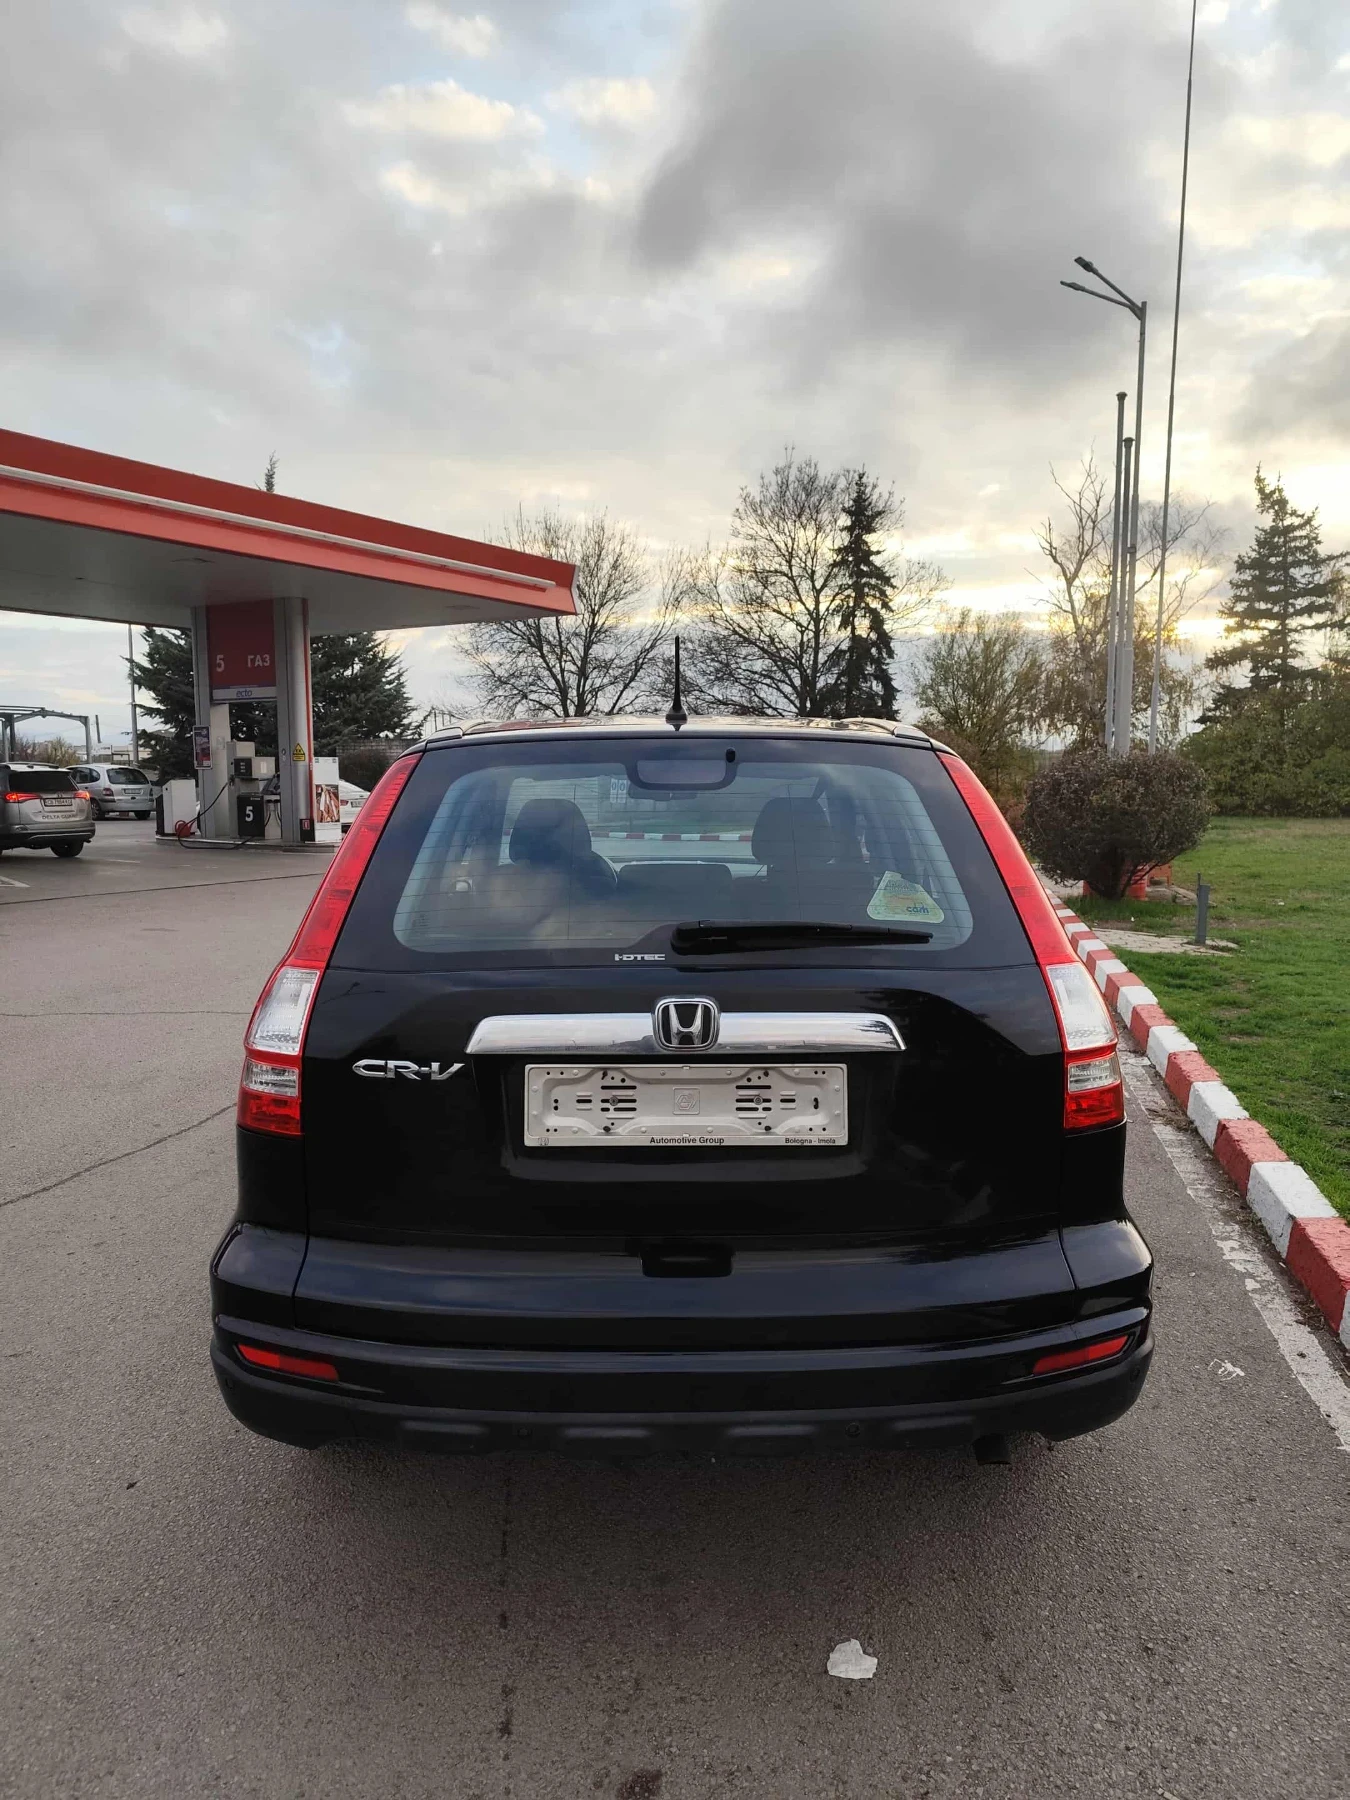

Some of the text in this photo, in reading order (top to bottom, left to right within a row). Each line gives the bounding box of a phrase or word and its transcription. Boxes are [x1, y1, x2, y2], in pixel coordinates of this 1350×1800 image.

[216, 654, 225, 672] 5
[247, 653, 270, 668] ГАЗ
[236, 689, 253, 698] ecto
[245, 806, 254, 822] 5
[352, 1059, 465, 1080] CR-V
[649, 1136, 725, 1146] Automotive Group
[784, 1137, 813, 1146] Bologna
[817, 1137, 836, 1145] Imola
